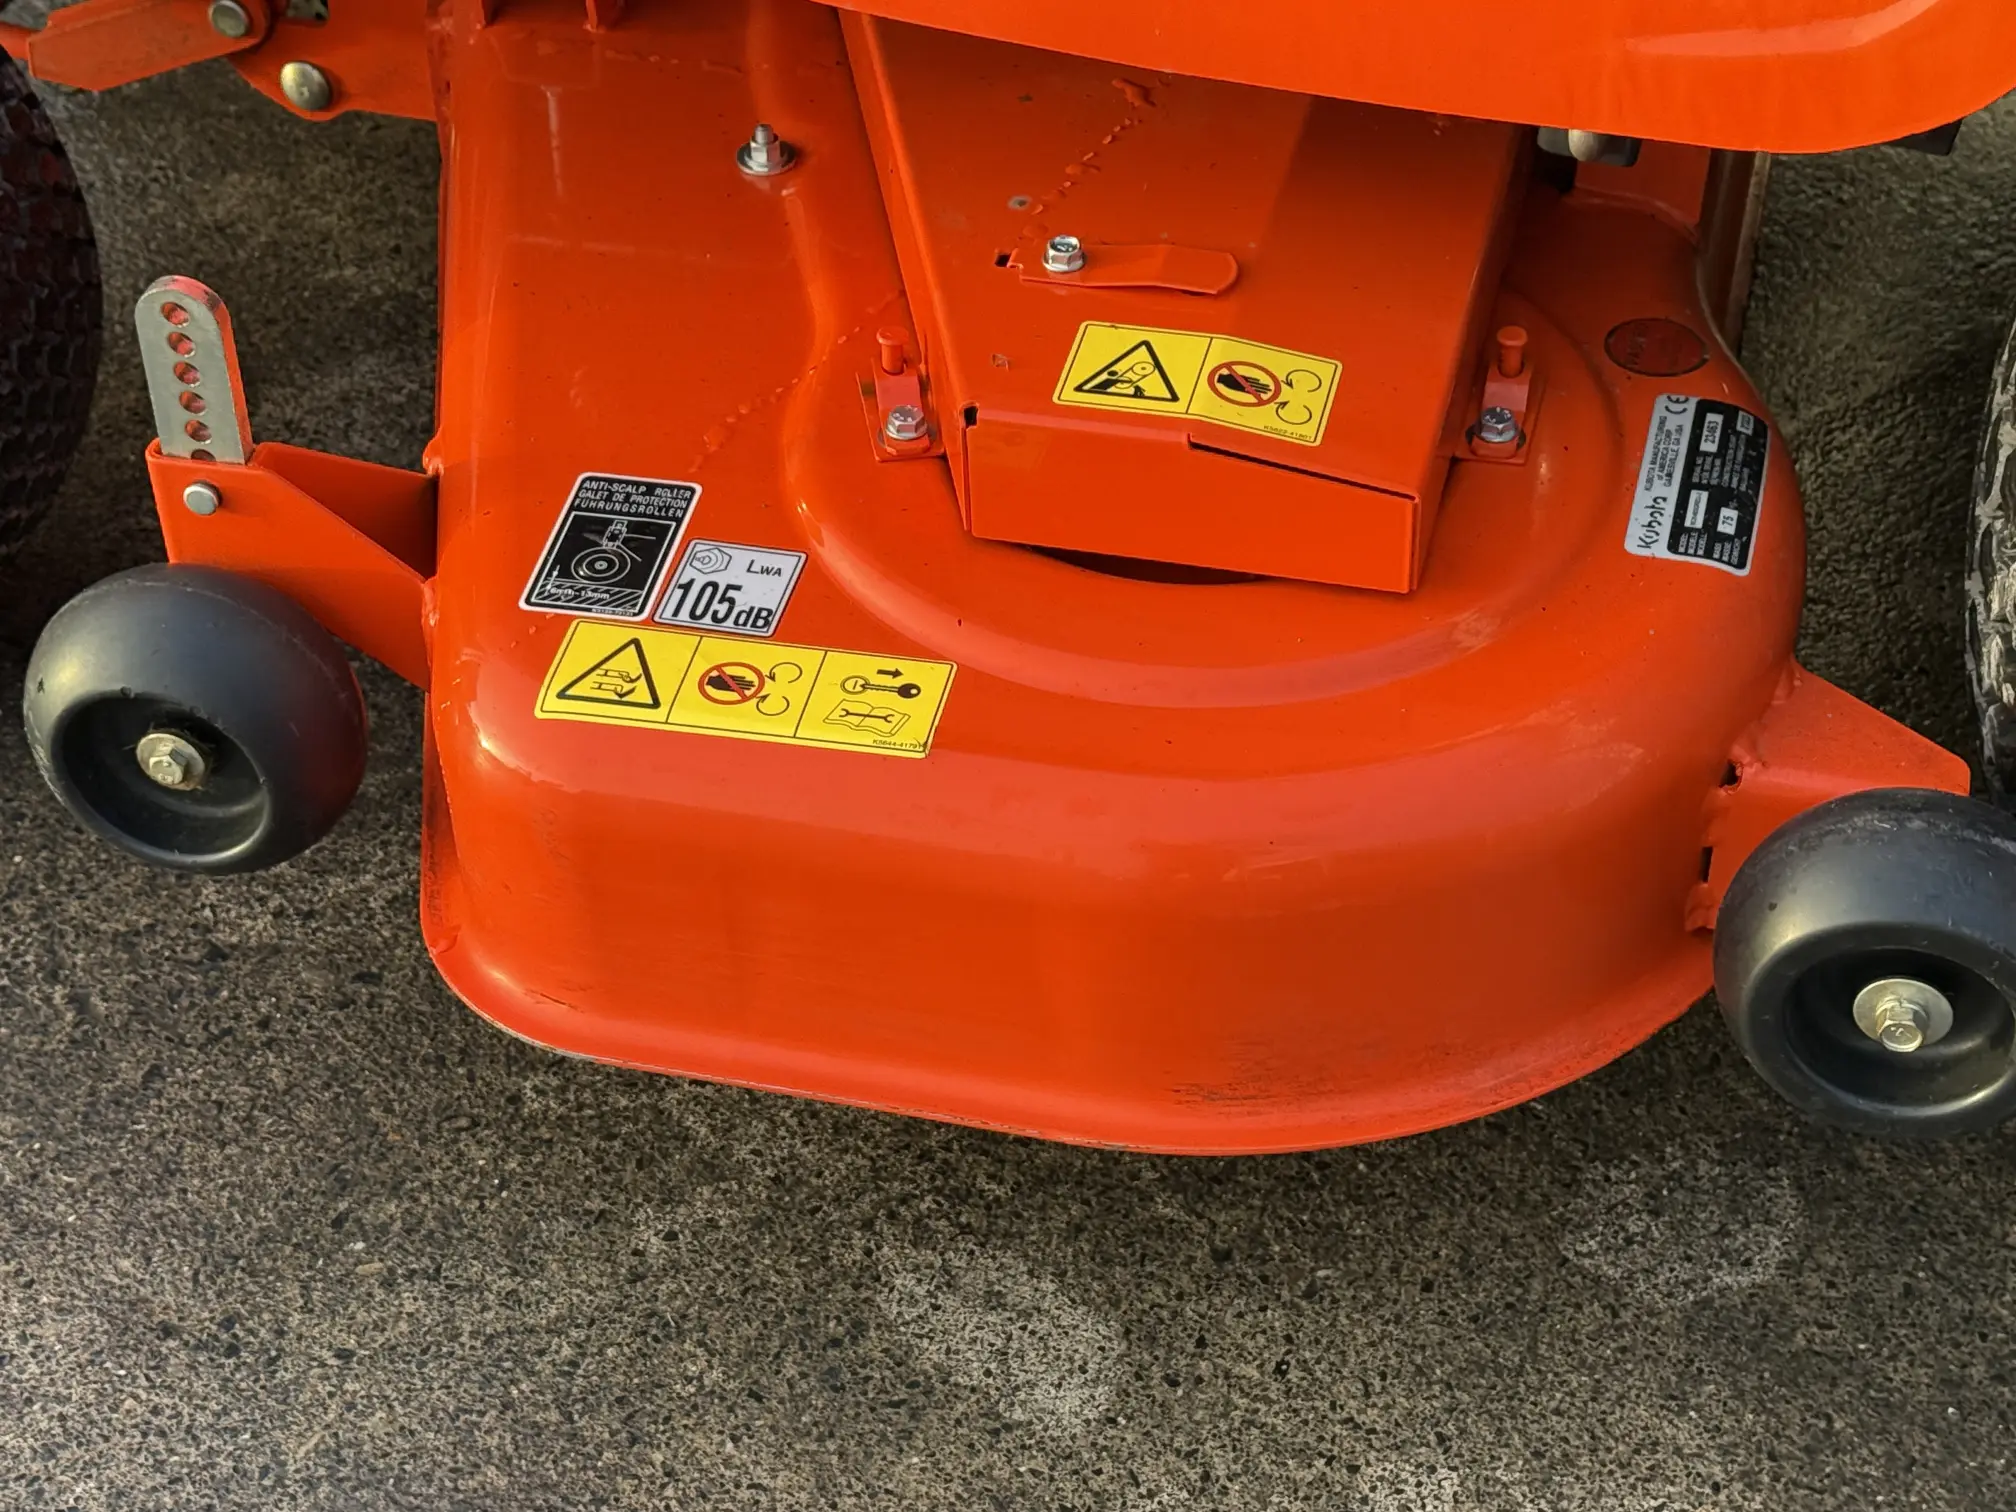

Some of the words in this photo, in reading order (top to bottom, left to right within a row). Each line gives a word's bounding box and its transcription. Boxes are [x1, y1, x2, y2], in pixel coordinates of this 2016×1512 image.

[1649, 415, 1667, 466] MANUFACTURING
[578, 489, 609, 500] GALET
[612, 493, 626, 501] DE
[630, 494, 688, 509] PROTECTION
[582, 480, 646, 494] ANTI-SCALP
[654, 487, 692, 499] ROLLER
[1637, 495, 1668, 549] Kubota
[1722, 515, 1734, 527] 75
